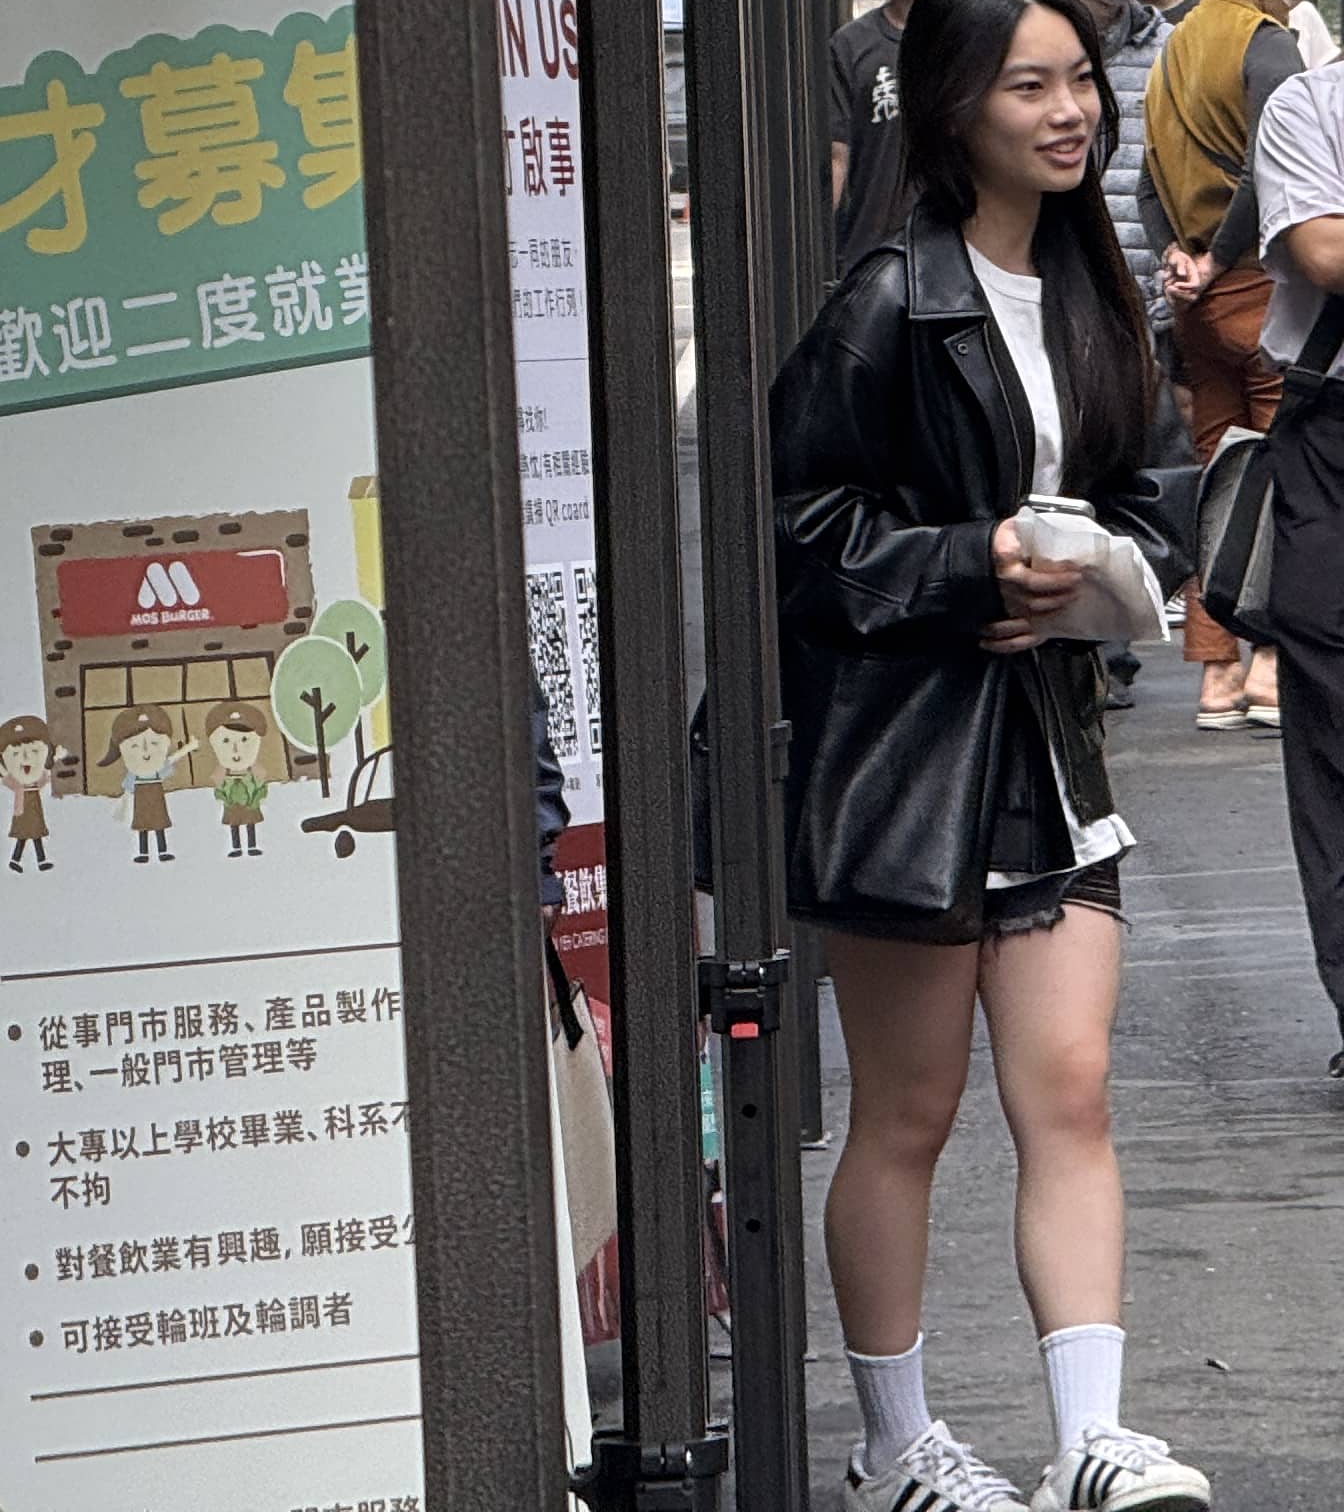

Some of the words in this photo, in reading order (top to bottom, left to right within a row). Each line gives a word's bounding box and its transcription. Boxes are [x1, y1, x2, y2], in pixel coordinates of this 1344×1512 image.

[130, 608, 159, 626] MOS
[162, 608, 210, 625] BURGER
[39, 988, 401, 1051] 從事門市服務、產品製作
[42, 1038, 317, 1095] 理、一般門市管理等
[50, 1173, 112, 1210] 不拘
[61, 1292, 355, 1353] 可接受輪班及輪調者
